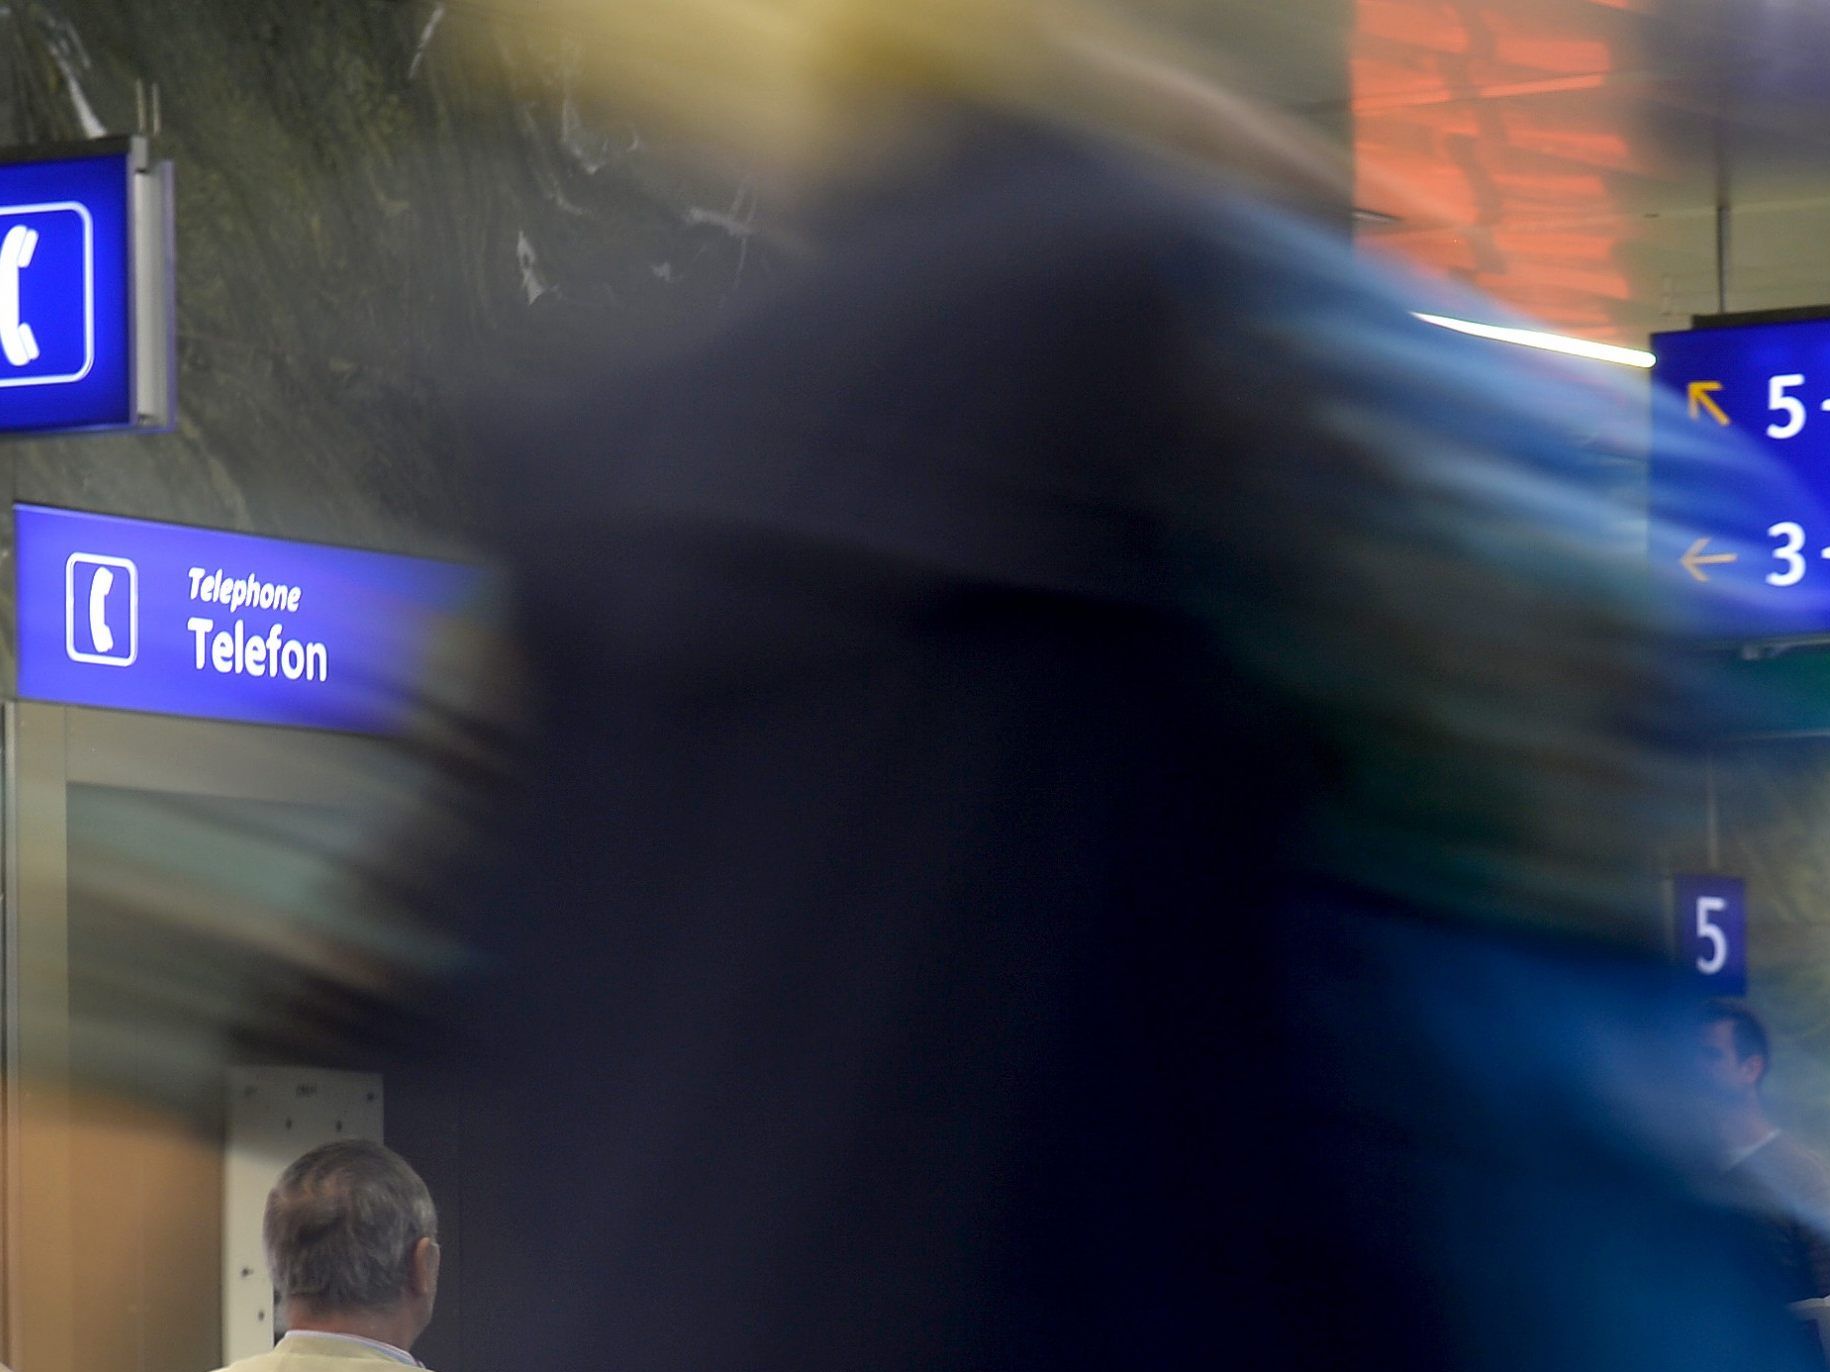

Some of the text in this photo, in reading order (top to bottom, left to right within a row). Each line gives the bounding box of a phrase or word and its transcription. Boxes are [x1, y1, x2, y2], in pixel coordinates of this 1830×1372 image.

[188, 567, 302, 613] Telephone
[187, 617, 328, 682] Telefon
[1696, 896, 1727, 973] 5
